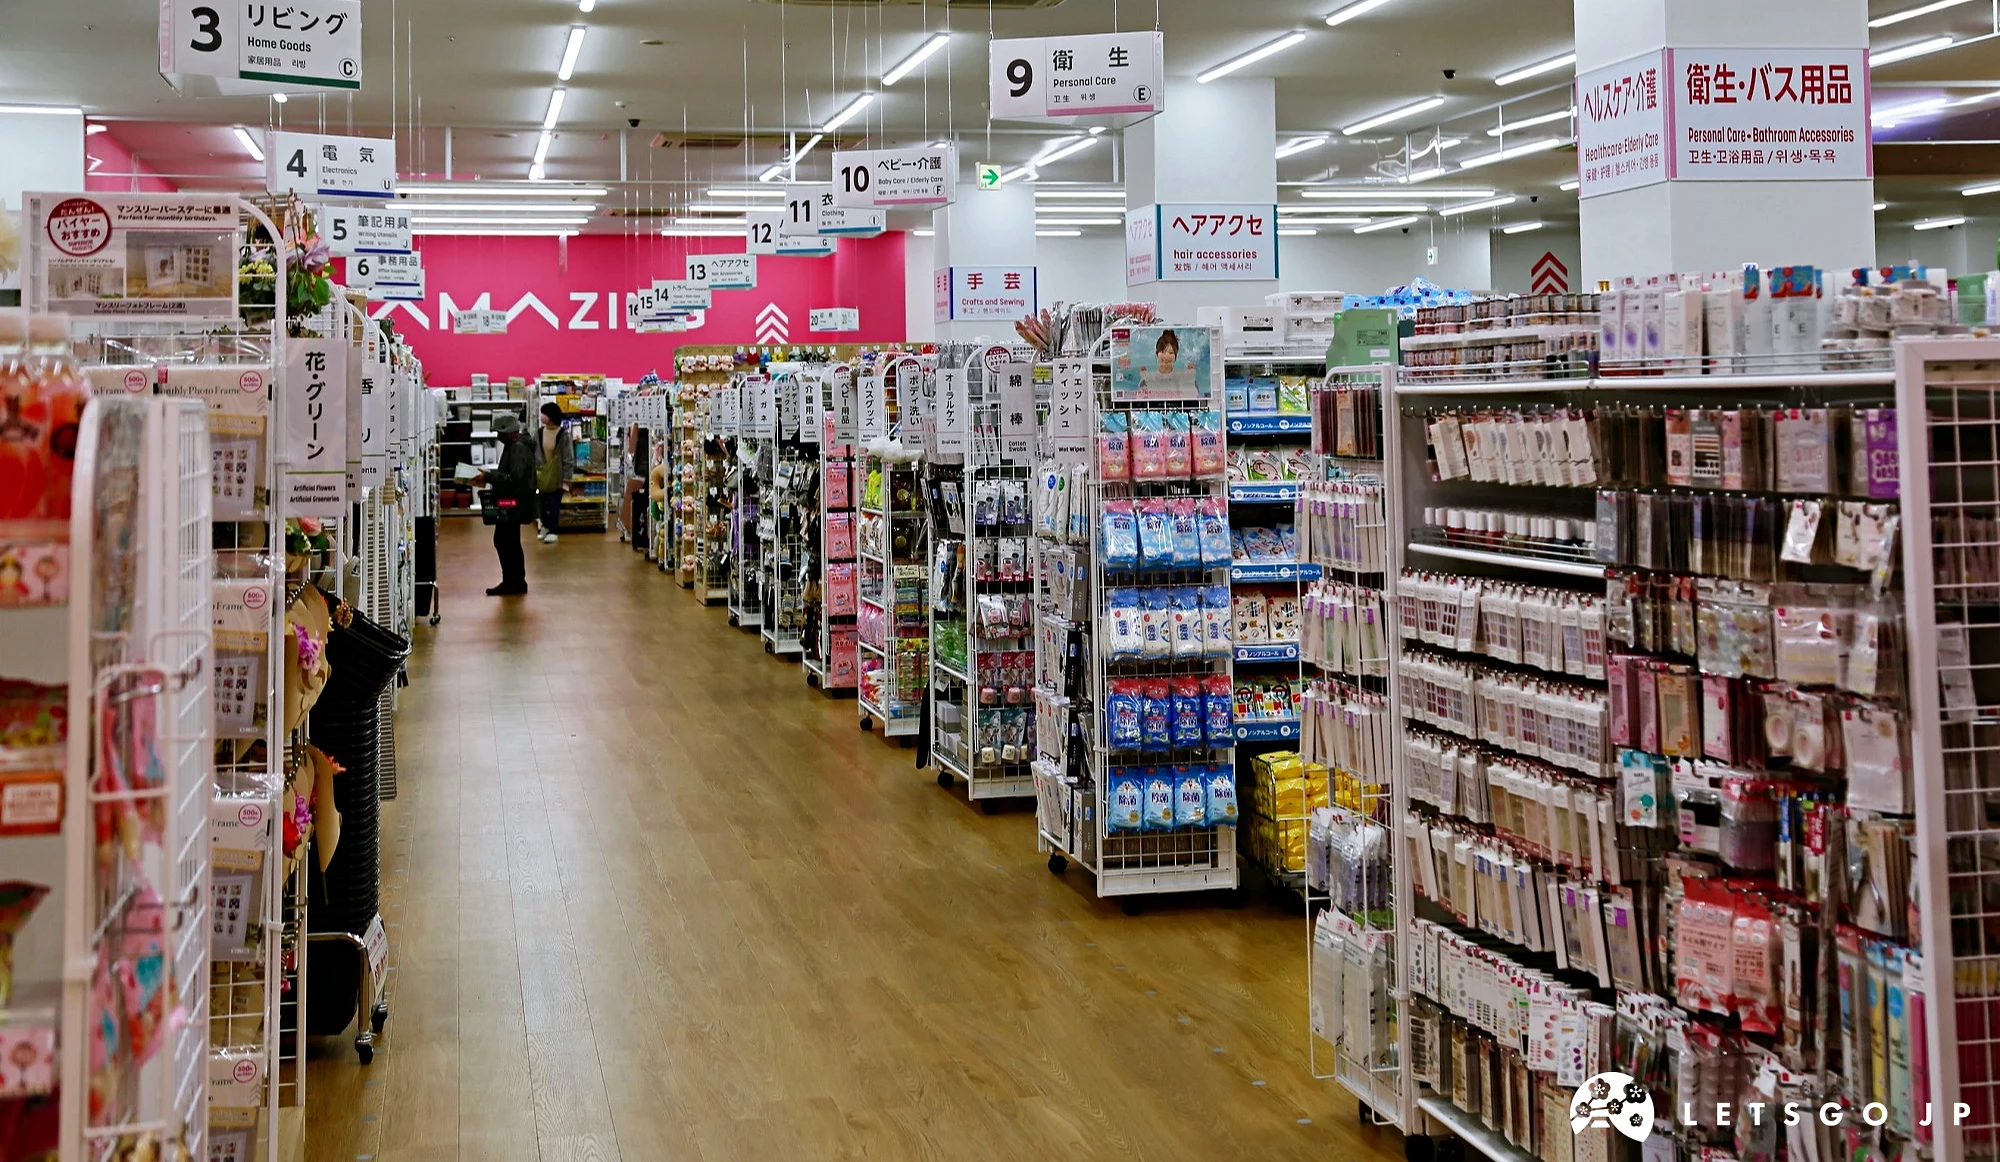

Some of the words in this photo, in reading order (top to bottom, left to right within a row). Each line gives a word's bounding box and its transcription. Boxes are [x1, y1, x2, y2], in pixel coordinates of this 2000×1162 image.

[248, 4, 348, 35] リビング
[190, 6, 222, 52] 3
[248, 36, 277, 49] Home
[280, 40, 312, 53] Goods
[292, 59, 306, 69] 리빙
[1052, 46, 1129, 71] 衛生
[343, 61, 353, 76] C
[1006, 58, 1033, 97] 9
[1053, 76, 1093, 88] Personal
[1095, 76, 1116, 85] Care
[1686, 62, 1852, 105] 衛生・バス用品
[1138, 87, 1146, 101] E
[1584, 67, 1657, 123] ヘルスケア・介護
[1644, 132, 1659, 149] Care
[1688, 126, 1725, 142] Personal
[1799, 125, 1855, 142] Accessories
[322, 144, 374, 163] 電気
[286, 148, 307, 178] 4
[322, 166, 358, 175] Electronics
[877, 156, 942, 172] ベビー・介護
[383, 180, 391, 190] U
[841, 165, 870, 193] 10
[878, 177, 892, 186] Baby
[910, 176, 929, 184] Elderly
[936, 185, 941, 195] F
[116, 204, 232, 216] マンスリーバースデーに最適
[789, 199, 810, 223] 11
[57, 217, 101, 229] バイヤー
[156, 215, 183, 223] monthly
[357, 214, 409, 229] 筆記用具
[1172, 213, 1263, 236] ヘアアクセ
[61, 228, 101, 240] おすすめ
[333, 218, 347, 240] 5
[358, 230, 377, 239] Writing
[751, 223, 772, 243] 12
[377, 255, 418, 267] 事務用品
[1173, 249, 1193, 259] hair
[1196, 248, 1257, 260] accessories
[357, 258, 370, 276] 6
[711, 258, 749, 268] ヘアアクセ
[689, 263, 706, 281] 13
[967, 272, 1021, 290] 手芸
[640, 296, 653, 309] 15
[654, 288, 669, 302] 14
[962, 298, 983, 306] Crafts
[985, 298, 997, 306] and
[999, 298, 1025, 307] Sewing
[188, 386, 214, 395] Photo
[215, 386, 241, 395] Frame
[1058, 363, 1070, 429] ティッシュ
[1072, 363, 1082, 415] ウェット
[305, 352, 326, 459] 花・グリーン
[841, 382, 850, 424] ベビー用品
[865, 380, 874, 427] バスグッズ
[909, 375, 920, 426] ボディ洗い
[945, 373, 955, 427] オーラルケア
[1009, 374, 1023, 426] 綿棒
[293, 484, 316, 492] Artificial
[290, 495, 312, 503] Artificial
[313, 495, 339, 503] Greeneries
[211, 1077, 235, 1086] rame
